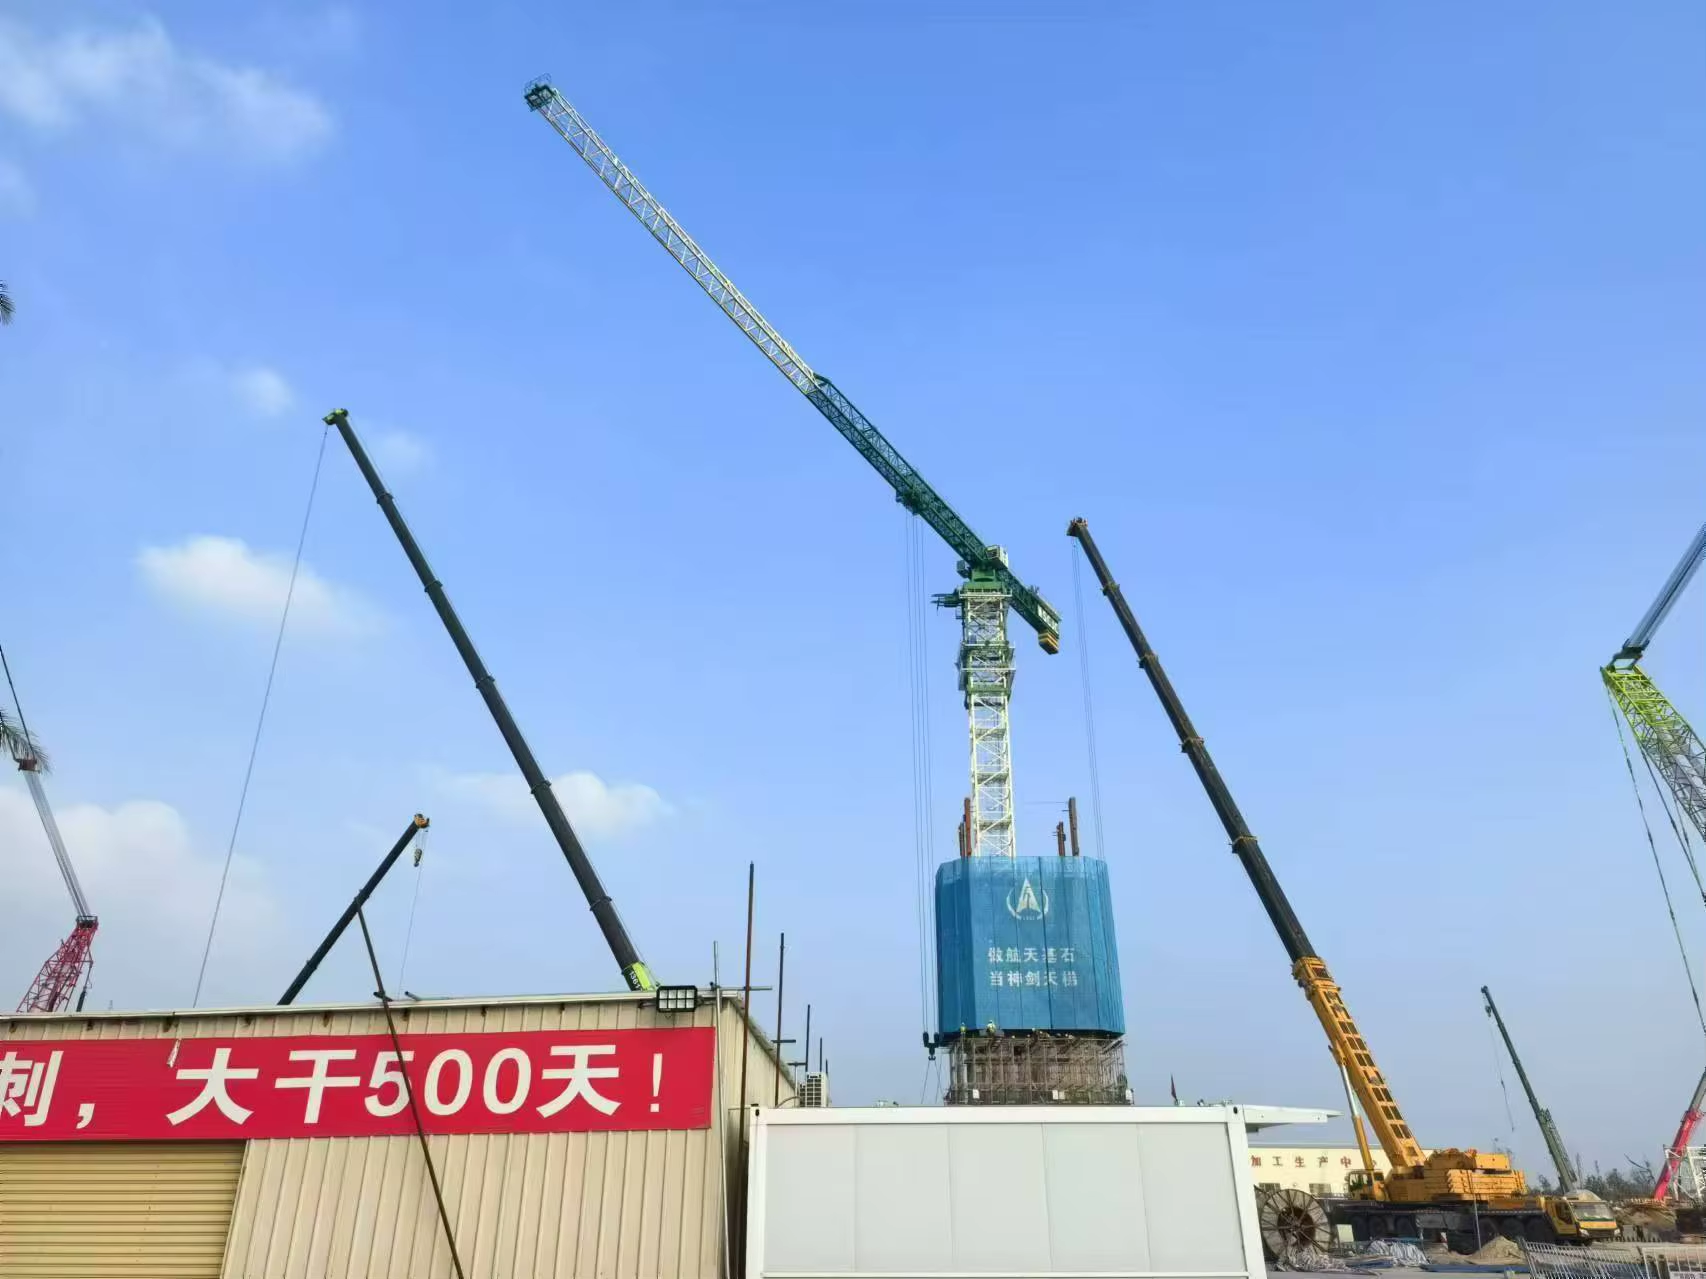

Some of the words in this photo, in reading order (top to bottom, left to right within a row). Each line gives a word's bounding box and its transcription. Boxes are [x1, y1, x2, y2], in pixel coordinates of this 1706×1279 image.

[1251, 1155, 1376, 1169] 加工生产中
